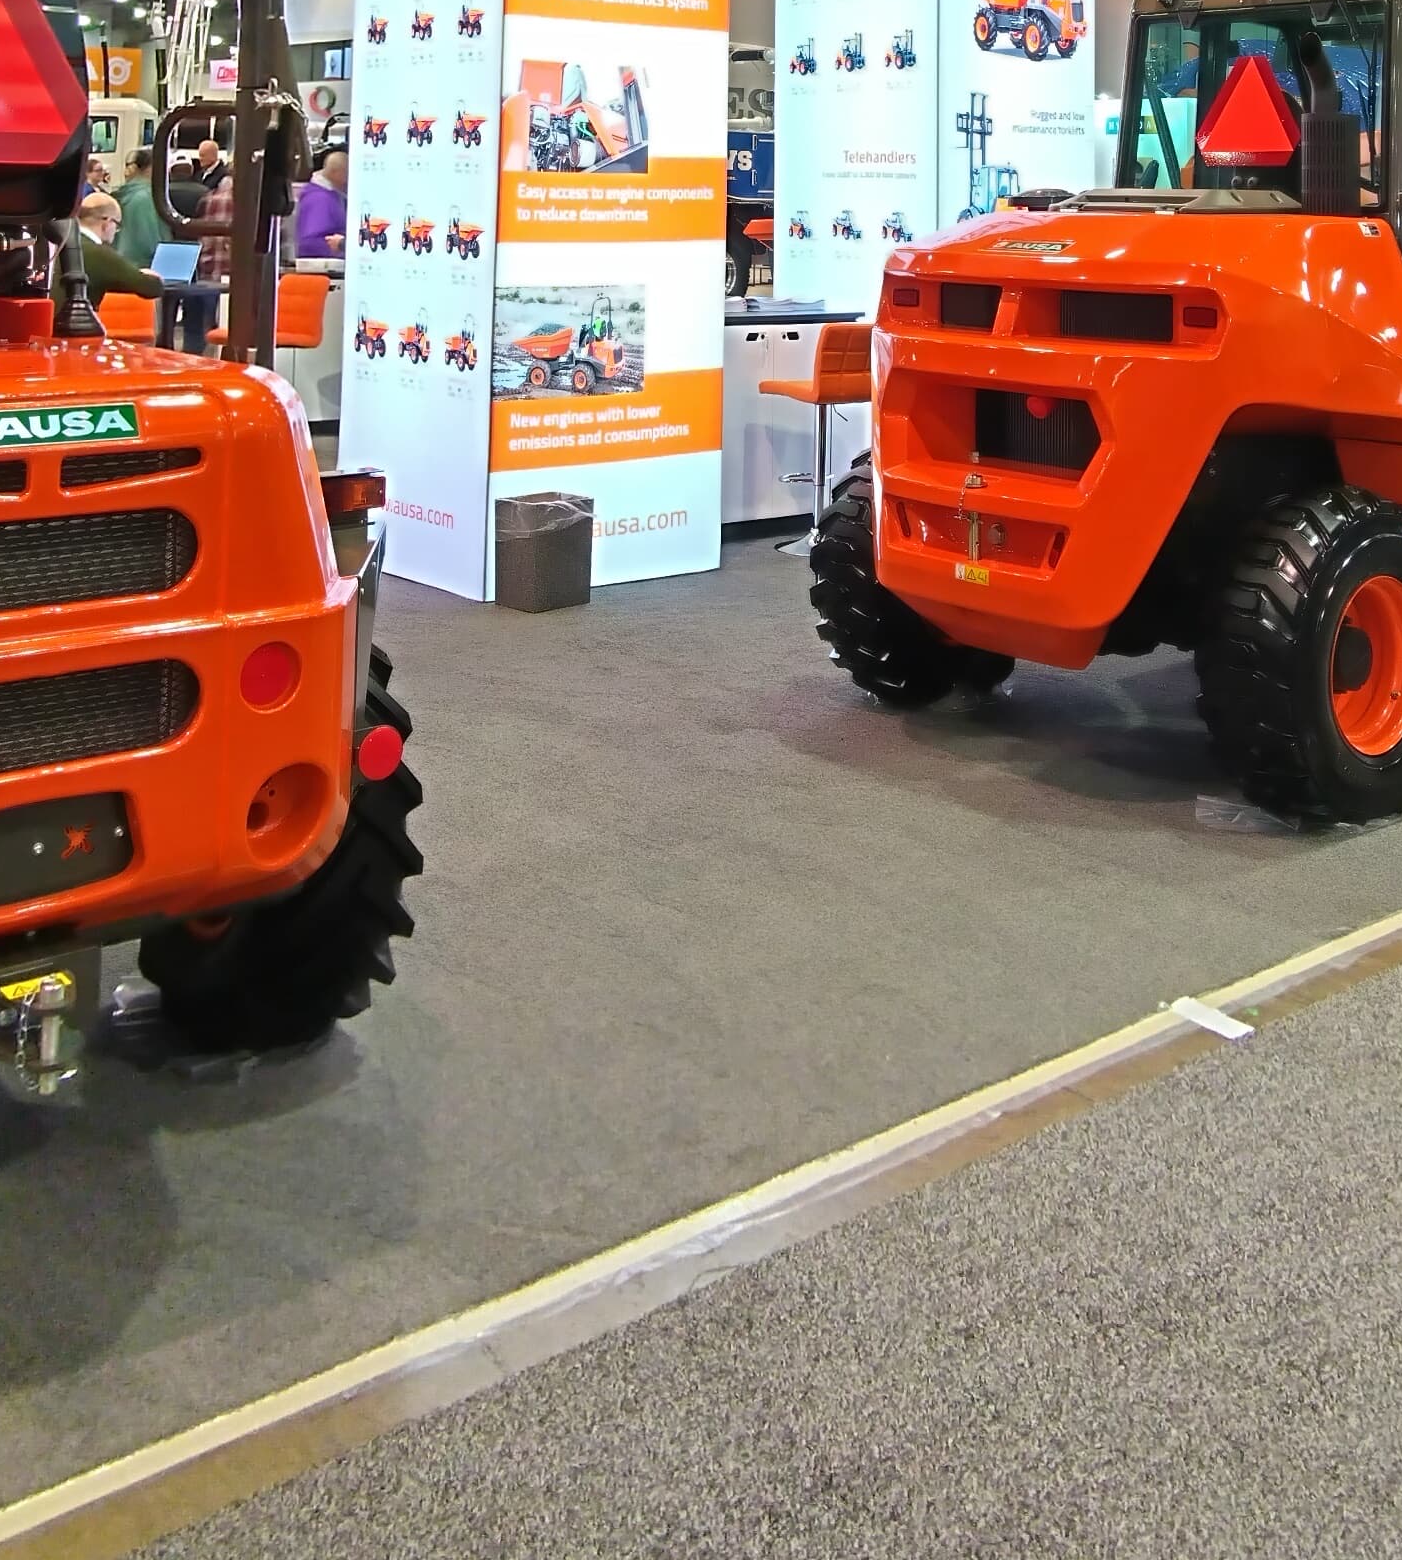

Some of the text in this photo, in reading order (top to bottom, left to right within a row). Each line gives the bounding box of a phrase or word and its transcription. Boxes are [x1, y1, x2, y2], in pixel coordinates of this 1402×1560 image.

[843, 150, 917, 165] Telehandlers
[517, 183, 714, 204] Easy access to engine components
[517, 206, 648, 222] to reduce downtimes
[1008, 242, 1064, 252] AUSA
[510, 405, 661, 430] New engines with lower
[509, 423, 690, 451] emissions and consumptions
